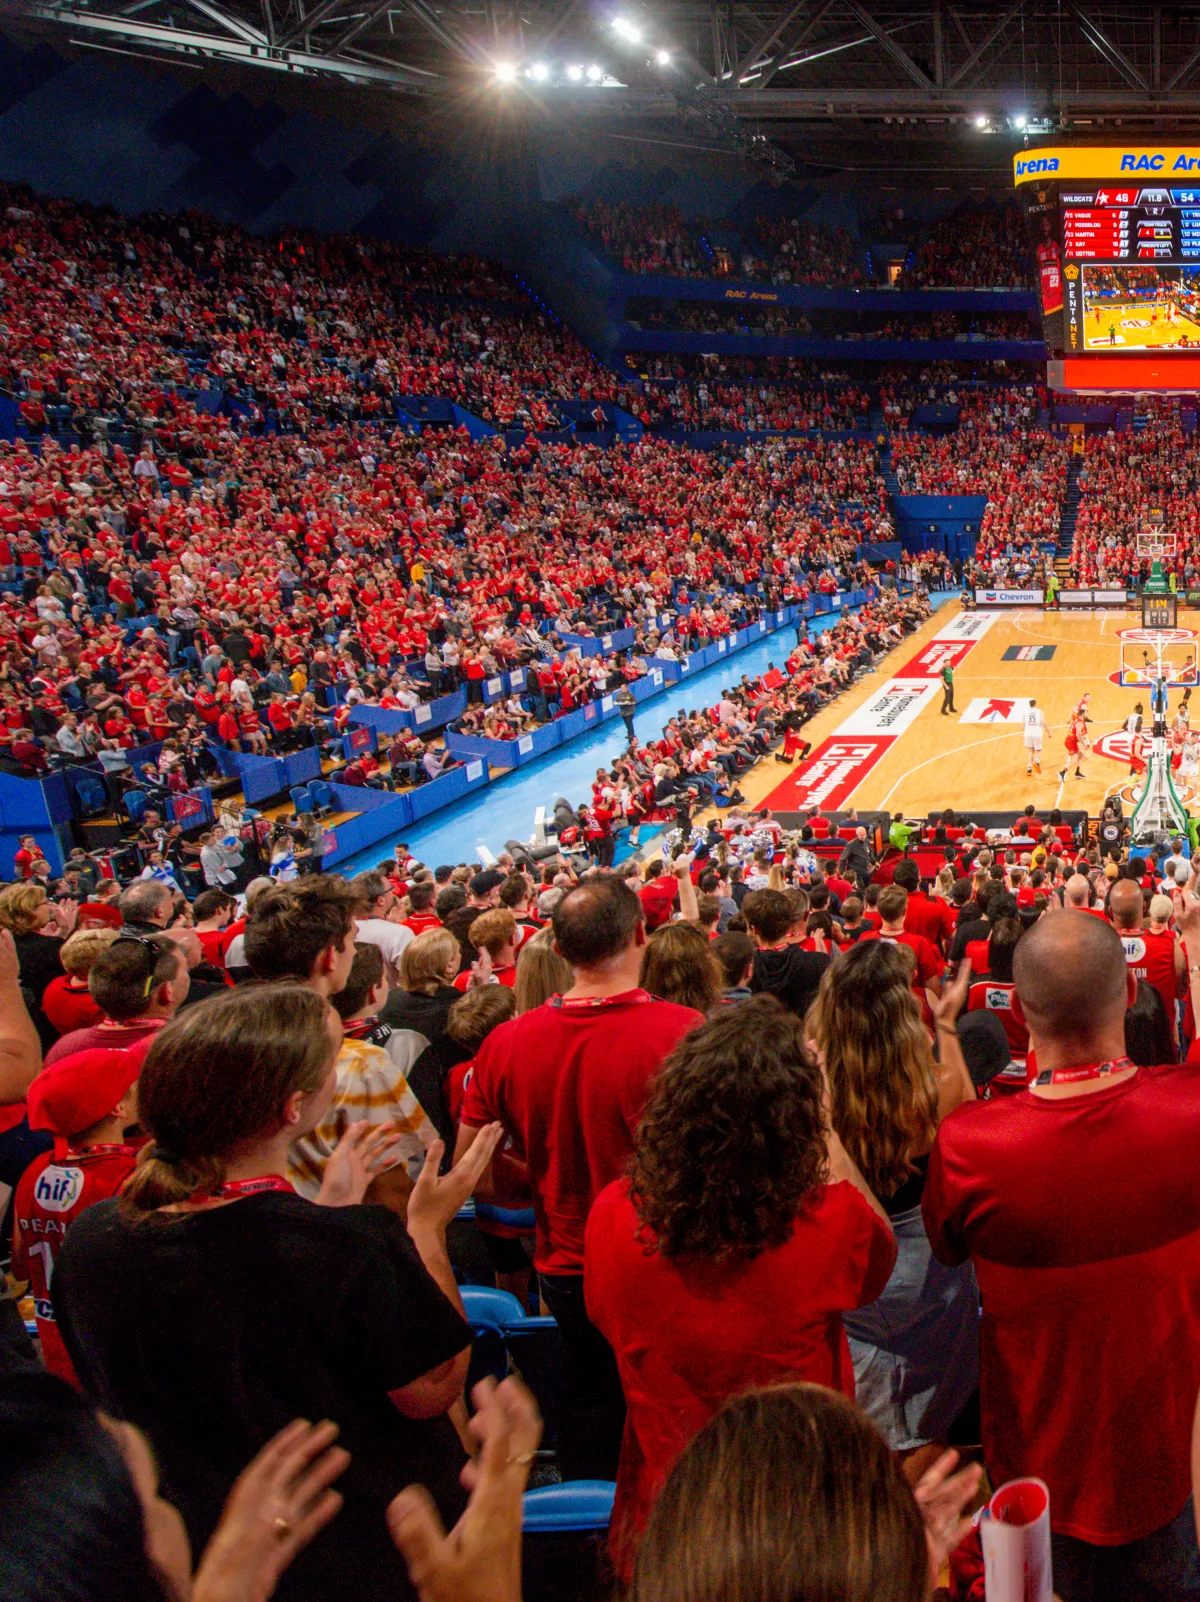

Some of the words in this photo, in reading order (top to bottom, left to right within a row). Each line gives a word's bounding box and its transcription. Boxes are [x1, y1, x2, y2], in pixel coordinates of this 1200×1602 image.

[1016, 158, 1059, 177] Arena
[1120, 154, 1165, 171] RAC
[1116, 193, 1129, 202] 46
[1181, 193, 1194, 202] 54
[725, 289, 747, 299] RAC
[749, 291, 777, 301] Arena
[1068, 282, 1077, 348] PENTANET
[37, 1175, 69, 1201] hif
